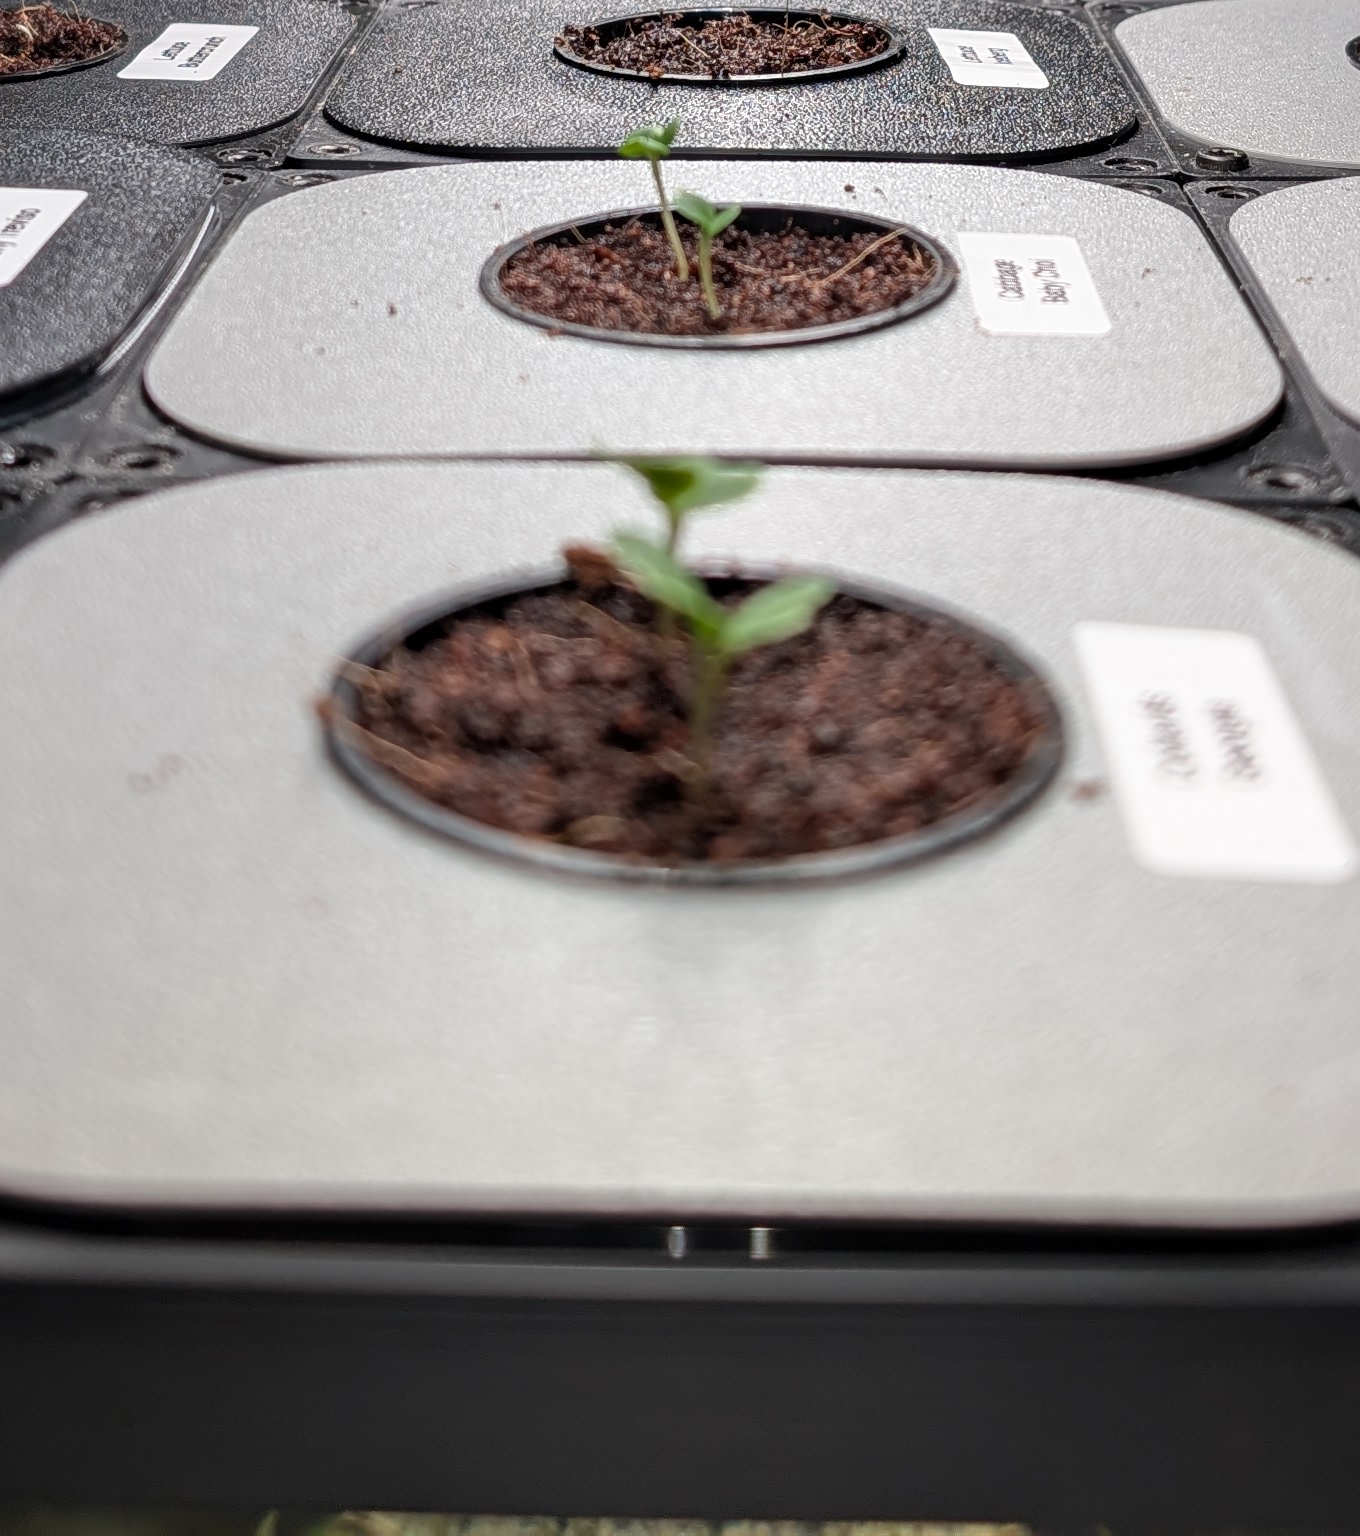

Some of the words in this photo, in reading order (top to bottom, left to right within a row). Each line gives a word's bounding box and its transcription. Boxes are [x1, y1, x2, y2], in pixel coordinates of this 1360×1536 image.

[154, 42, 190, 60] Lettuce
[177, 37, 227, 68] Buttercrunch
[994, 259, 1025, 298] Cabbage
[1029, 259, 1059, 279] Choi
[1041, 279, 1070, 302] Baby
